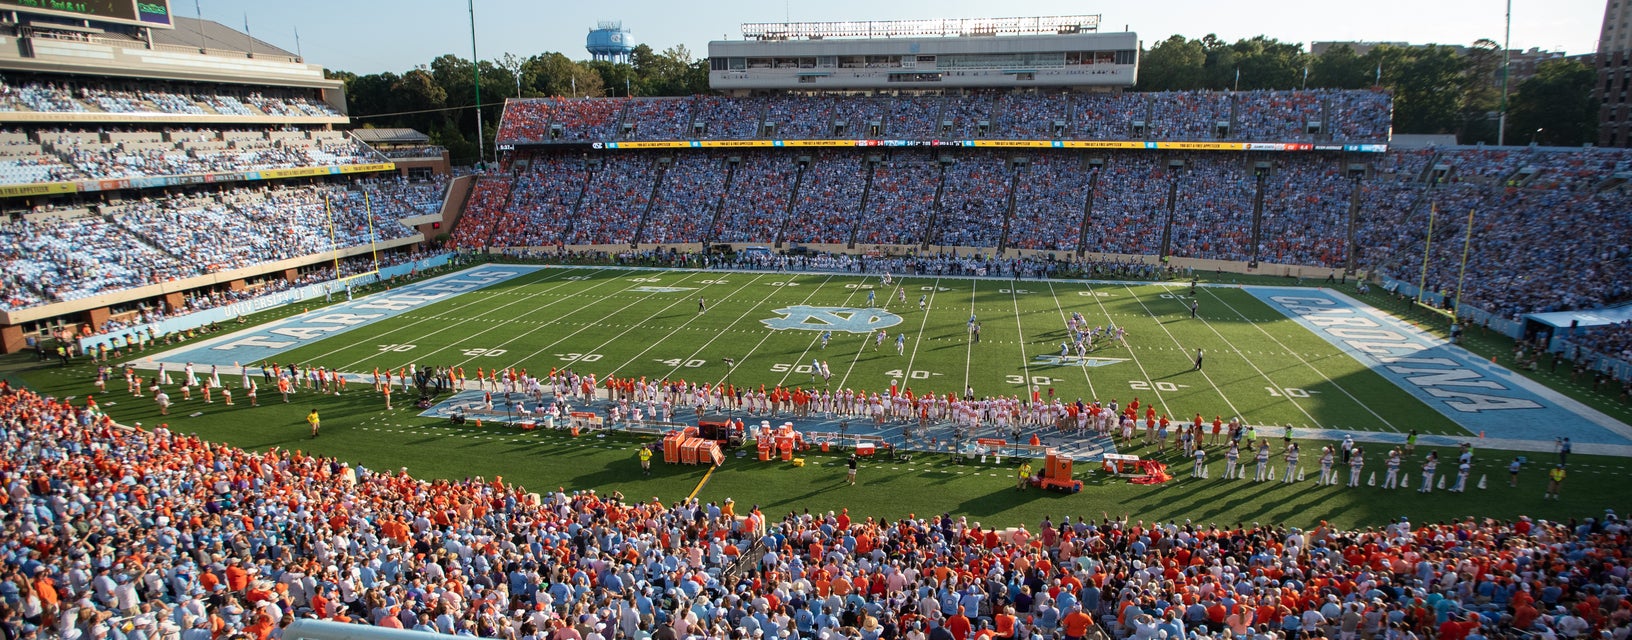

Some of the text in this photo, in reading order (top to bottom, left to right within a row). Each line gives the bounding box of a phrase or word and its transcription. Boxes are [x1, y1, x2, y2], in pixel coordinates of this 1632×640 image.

[224, 291, 290, 316] UNIVERSITY
[295, 288, 305, 300] OF
[209, 270, 519, 351] TAR HEELS
[378, 344, 417, 352] 10
[463, 348, 508, 357] 20
[560, 353, 604, 362] 30
[1266, 295, 1548, 414] CAROLINA
[663, 358, 706, 368] 40
[770, 363, 813, 374] 50
[884, 369, 930, 379] 40
[1005, 374, 1051, 386] 30
[1128, 380, 1178, 391] 20
[1264, 386, 1310, 398] 10
